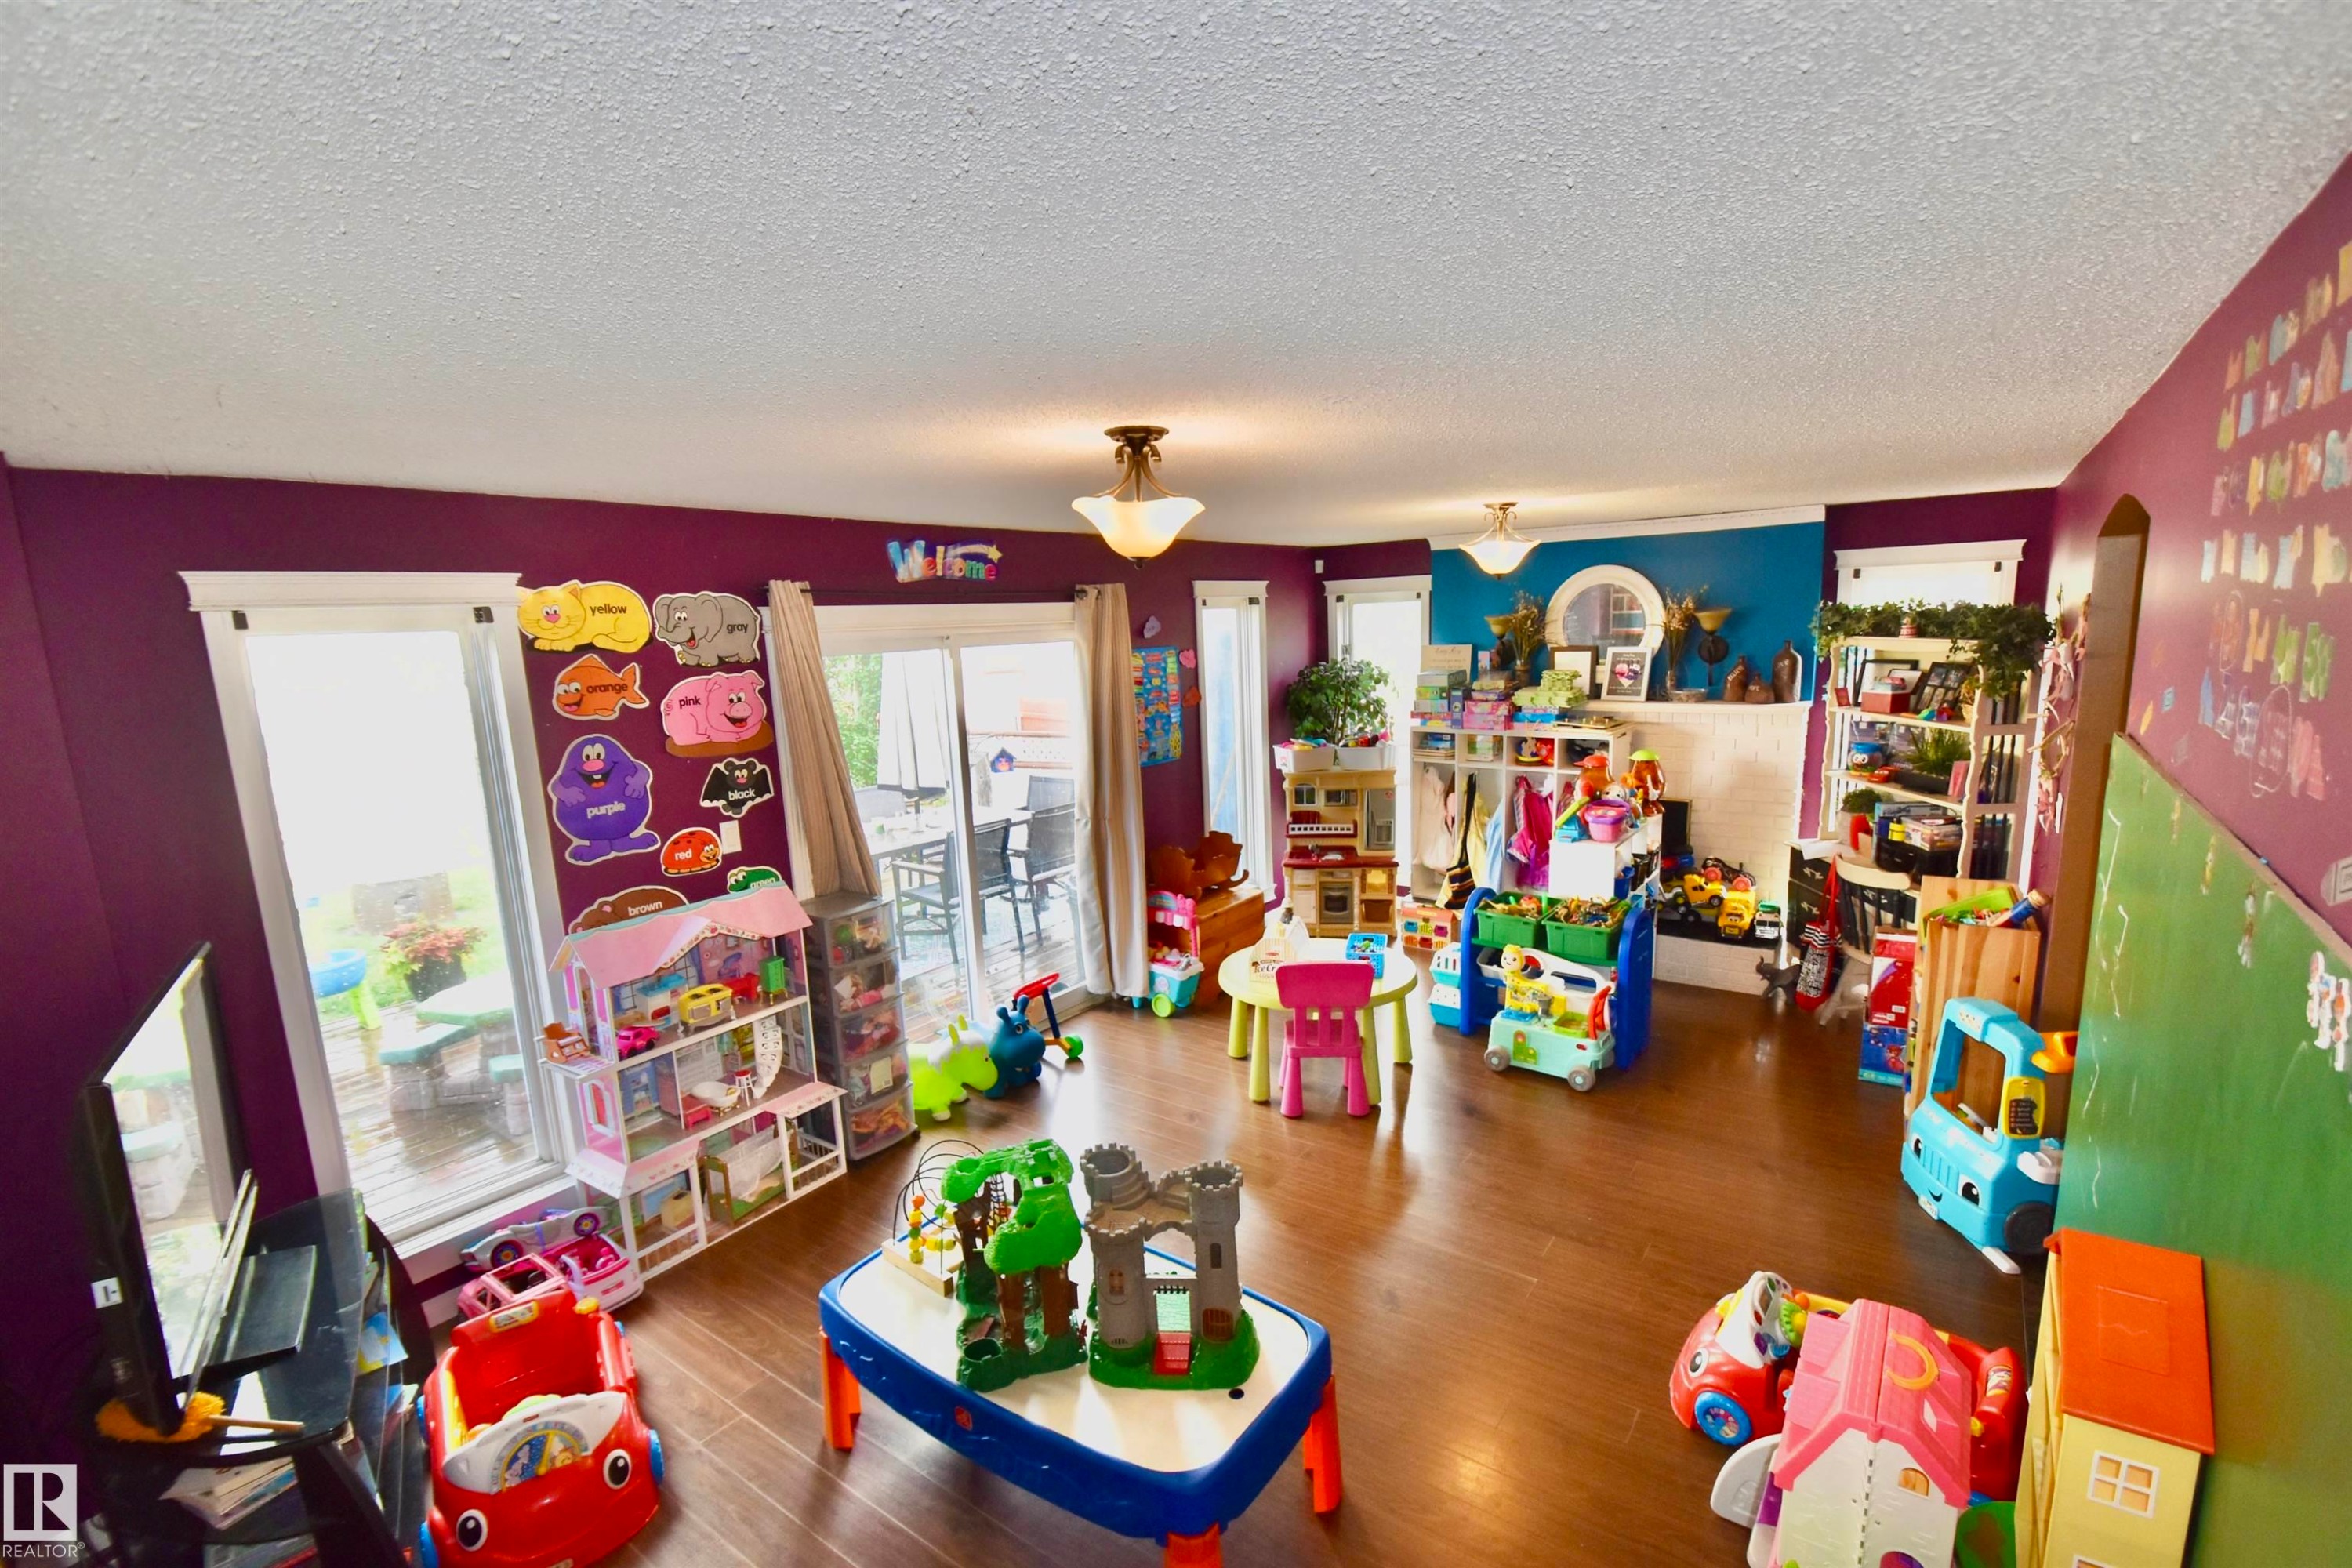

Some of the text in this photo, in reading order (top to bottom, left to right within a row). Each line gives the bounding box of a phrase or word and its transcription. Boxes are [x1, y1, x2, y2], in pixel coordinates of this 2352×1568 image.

[887, 540, 997, 582] Welcome
[590, 604, 627, 615] yellow
[727, 622, 749, 635] gray
[586, 680, 628, 695] orange
[679, 695, 701, 709] pink
[728, 787, 756, 800] black
[586, 800, 626, 818] purple
[675, 849, 692, 861] red
[750, 877, 776, 888] green
[628, 900, 663, 916] brown
